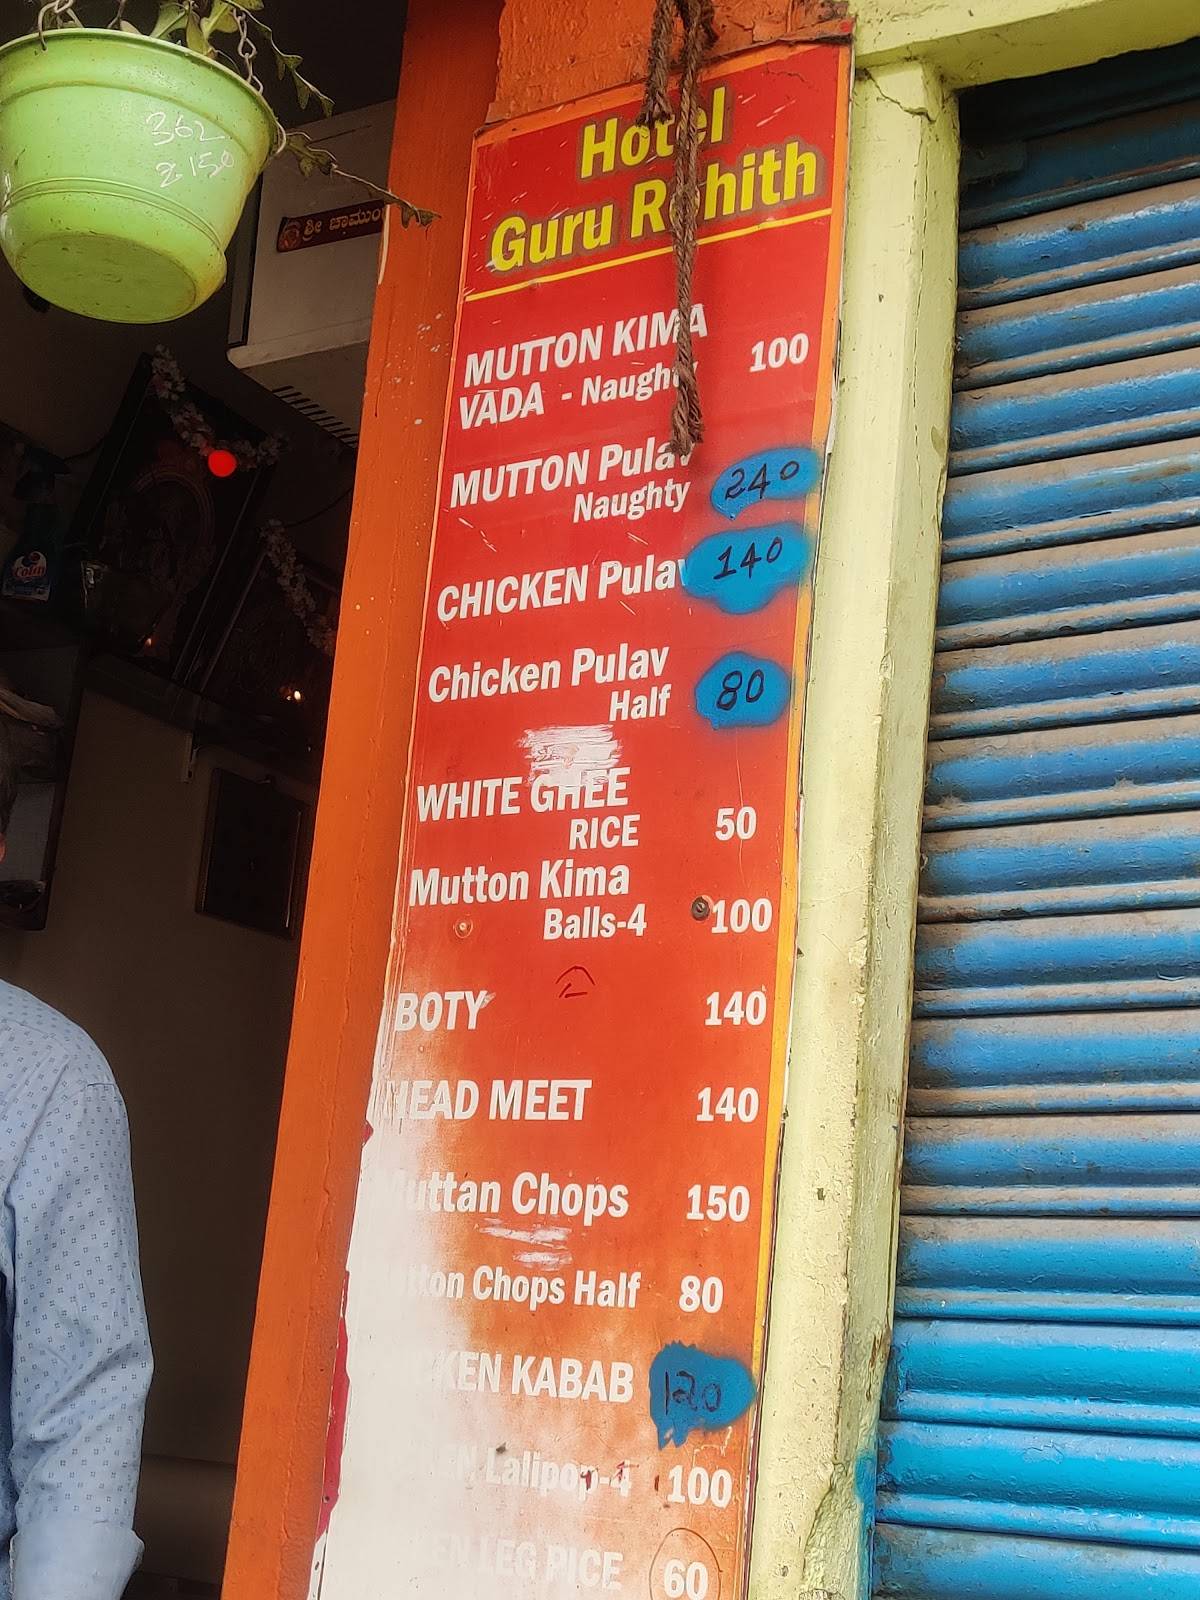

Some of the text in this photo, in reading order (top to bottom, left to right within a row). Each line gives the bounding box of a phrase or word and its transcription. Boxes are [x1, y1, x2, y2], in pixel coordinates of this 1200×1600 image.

[146, 111, 226, 146] 362
[491, 142, 817, 272] Guru Rhith
[463, 303, 708, 388] MUTTON KIMA
[749, 333, 810, 374] 100
[459, 361, 698, 431] VADA - Naught
[449, 449, 590, 508] MUTTON
[725, 461, 800, 500] 240
[573, 478, 691, 523] Naughty
[713, 537, 783, 580] 140
[437, 563, 588, 622] CHICKEN
[428, 642, 670, 703] Chicken Pulav
[716, 669, 765, 711] 80
[608, 684, 672, 722] Half
[417, 767, 631, 822] WHITE GHEE
[569, 814, 640, 850] RICE
[715, 806, 757, 841] 50
[409, 859, 630, 906] Mutton Kima
[543, 904, 647, 940] Balls-4
[711, 898, 773, 934] 100
[395, 990, 488, 1032] BOTY
[704, 991, 767, 1026] 140
[489, 1079, 592, 1121] MEET
[696, 1087, 759, 1123] 140
[511, 1172, 629, 1226] Chops
[686, 1184, 750, 1222] 150
[473, 1265, 565, 1311] Chops
[574, 1270, 641, 1308] Half
[679, 1276, 724, 1314] 80
[512, 1354, 634, 1403] KABAB
[667, 1464, 733, 1509] 100
[664, 1559, 709, 1600] 60
